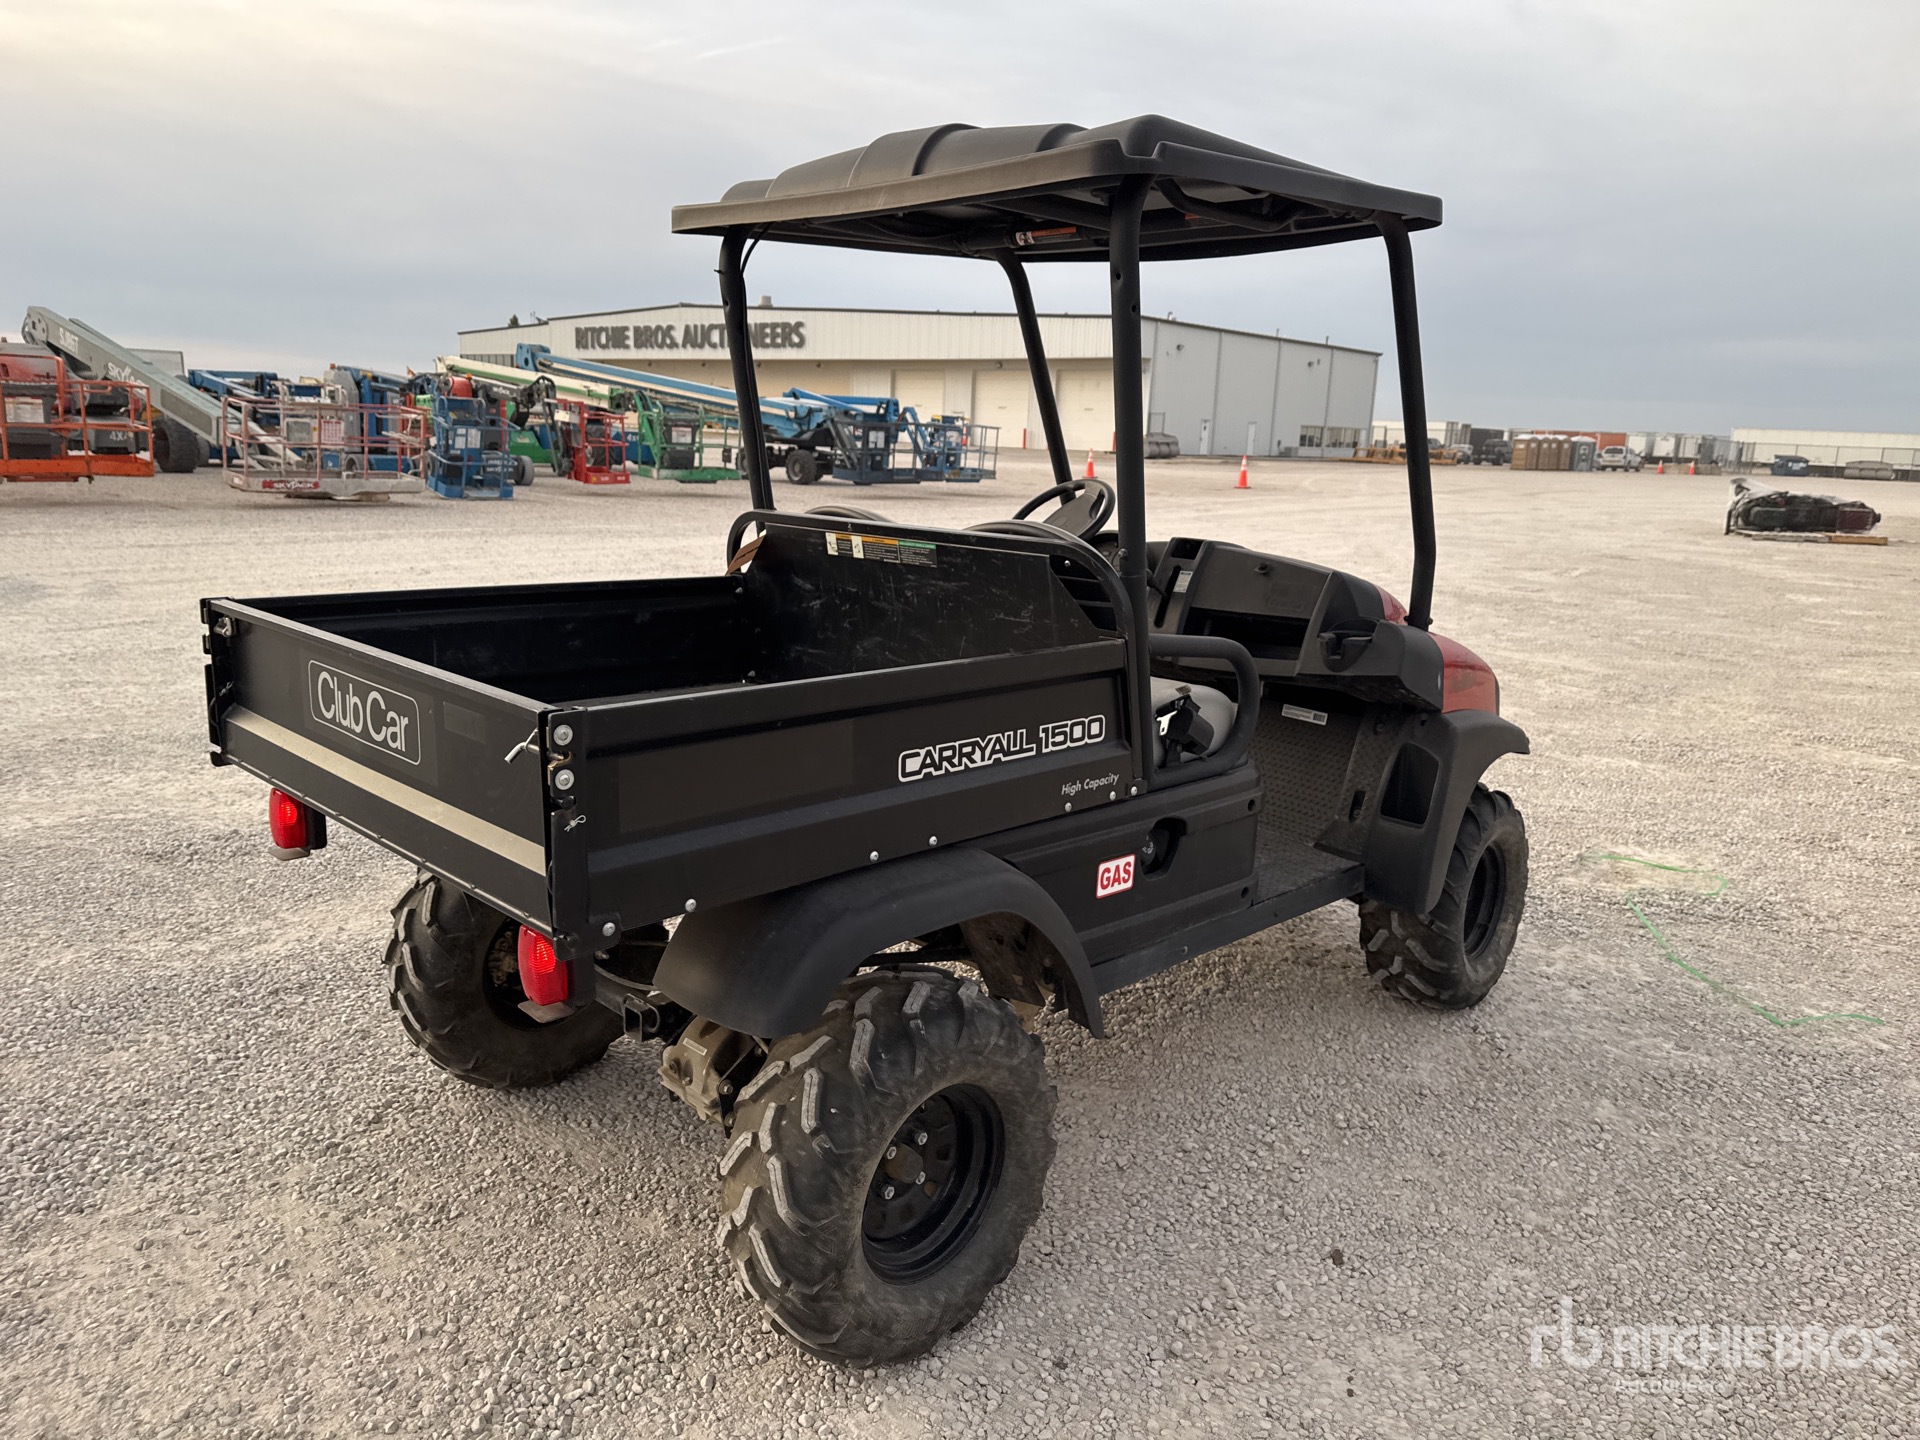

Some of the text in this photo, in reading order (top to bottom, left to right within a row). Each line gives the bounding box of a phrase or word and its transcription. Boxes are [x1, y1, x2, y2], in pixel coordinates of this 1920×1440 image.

[575, 321, 806, 349] RITCHIE BROS. AUCTNEERS
[317, 671, 409, 752] Club Car
[898, 714, 1105, 782] CARRYALL 1500
[1061, 773, 1119, 796] High Capacity
[1100, 861, 1132, 890] GAS
